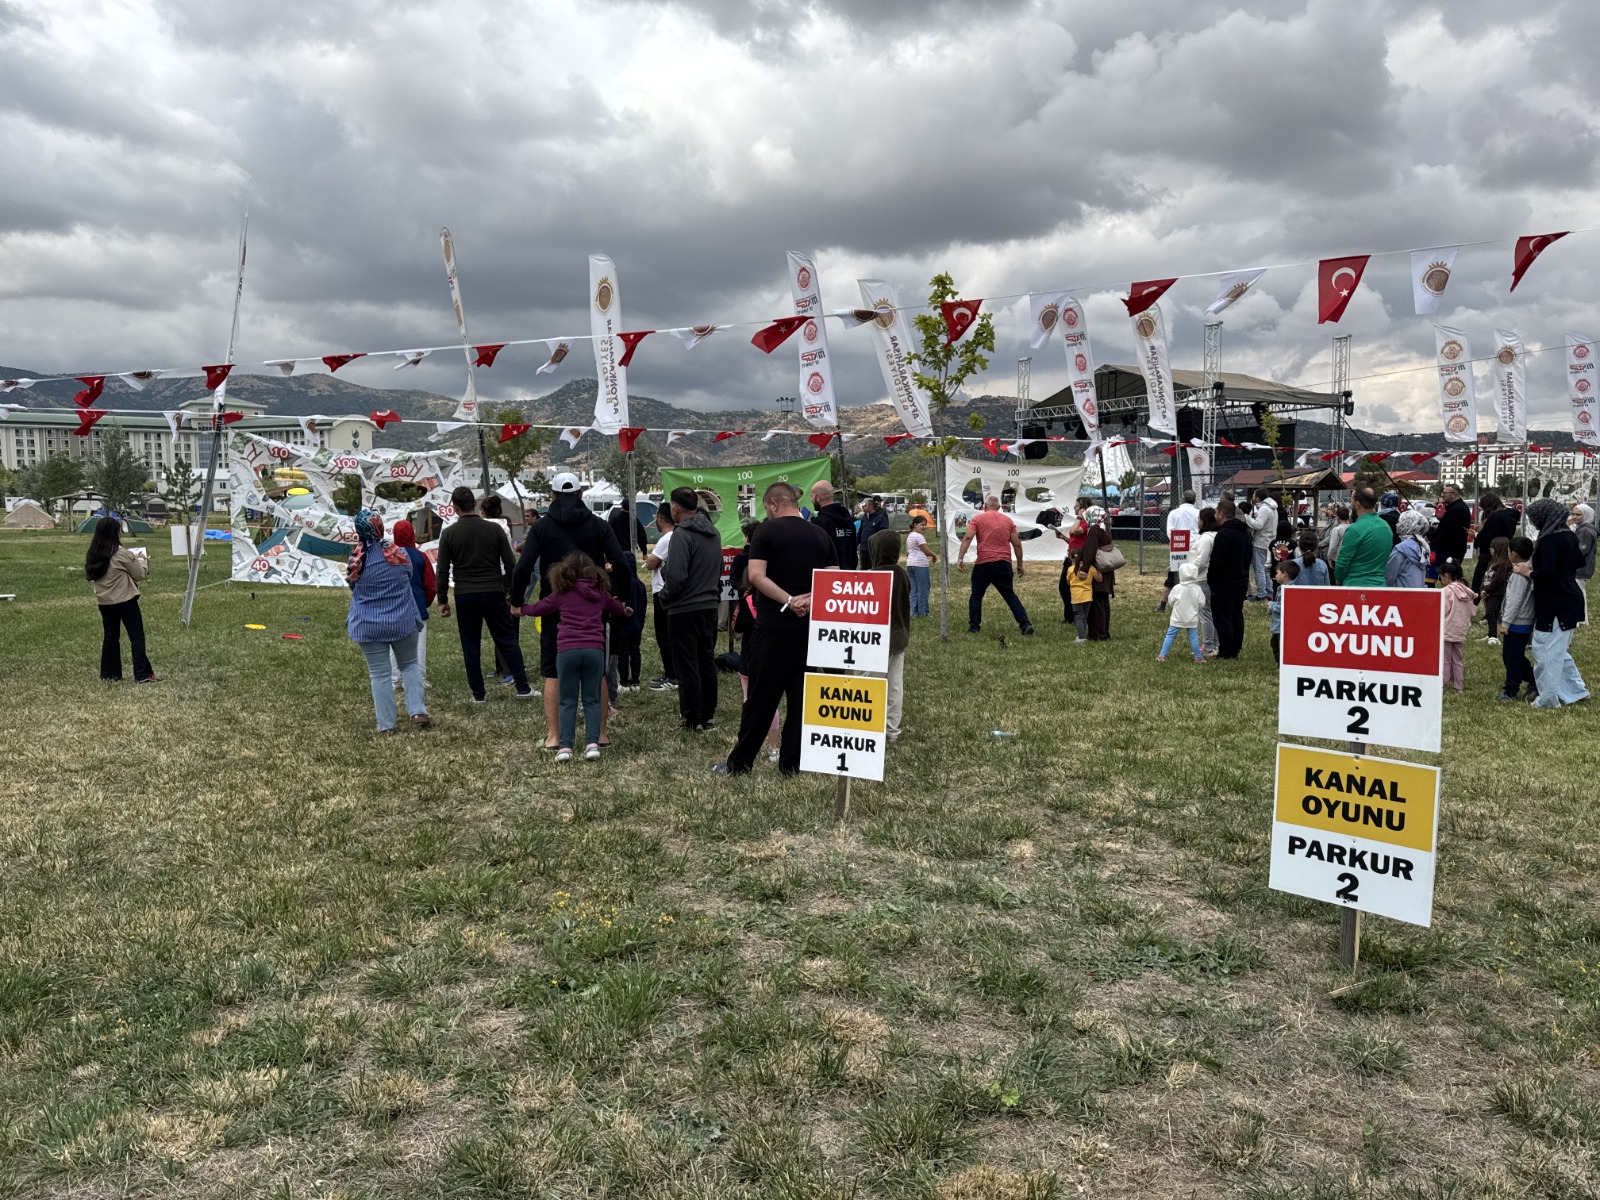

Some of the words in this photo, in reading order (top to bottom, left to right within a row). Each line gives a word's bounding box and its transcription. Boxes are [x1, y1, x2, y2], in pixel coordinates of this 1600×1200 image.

[272, 448, 290, 459] 10
[335, 458, 358, 468] 100
[972, 466, 982, 474] 10
[391, 466, 408, 478] 20
[692, 474, 704, 484] 10
[737, 470, 752, 480] 100
[778, 474, 788, 482] 20
[1008, 468, 1020, 476] 100
[439, 505, 455, 516] 30
[343, 532, 360, 542] 50
[252, 559, 270, 572] 40
[728, 588, 736, 598] 4
[832, 580, 874, 596] SAKA
[825, 599, 879, 614] OYUNU
[1318, 603, 1403, 627] SAKA
[818, 628, 882, 646] PARKUR
[1307, 632, 1414, 658] OYUNU
[844, 646, 856, 664] 1
[820, 686, 872, 704] KANAL
[1296, 676, 1422, 708] PARKUR
[818, 704, 872, 722] OYUNU
[1346, 706, 1370, 736] 2
[810, 732, 876, 753] PARKUR
[836, 752, 849, 772] 1
[1304, 767, 1406, 804] KANAL
[1302, 795, 1406, 832] OYUNU
[1288, 834, 1414, 882] PARKUR
[1336, 872, 1360, 902] 2
